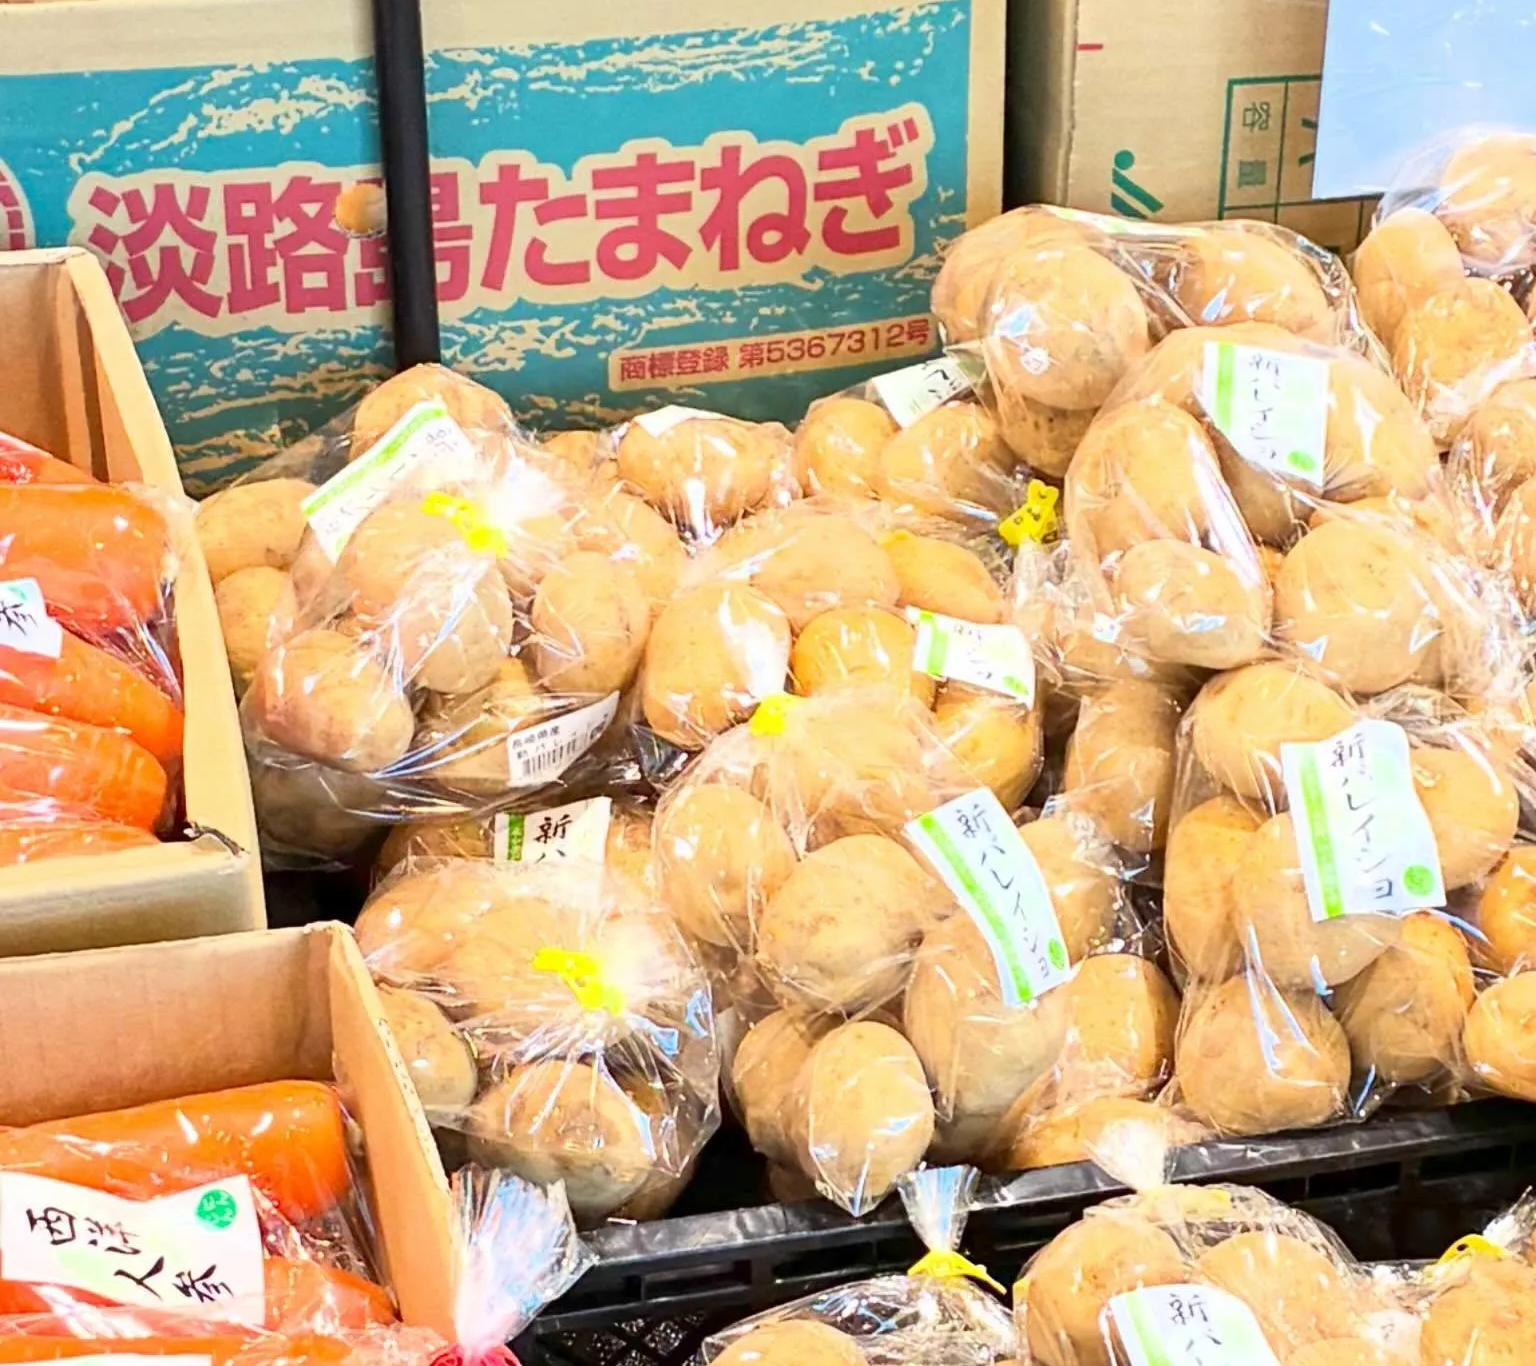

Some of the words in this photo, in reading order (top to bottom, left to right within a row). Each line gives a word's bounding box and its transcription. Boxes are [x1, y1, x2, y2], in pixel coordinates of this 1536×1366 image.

[619, 346, 730, 382] 商標登録
[737, 317, 931, 370] 第5367312号
[26, 1206, 235, 1304] 西洋人参
